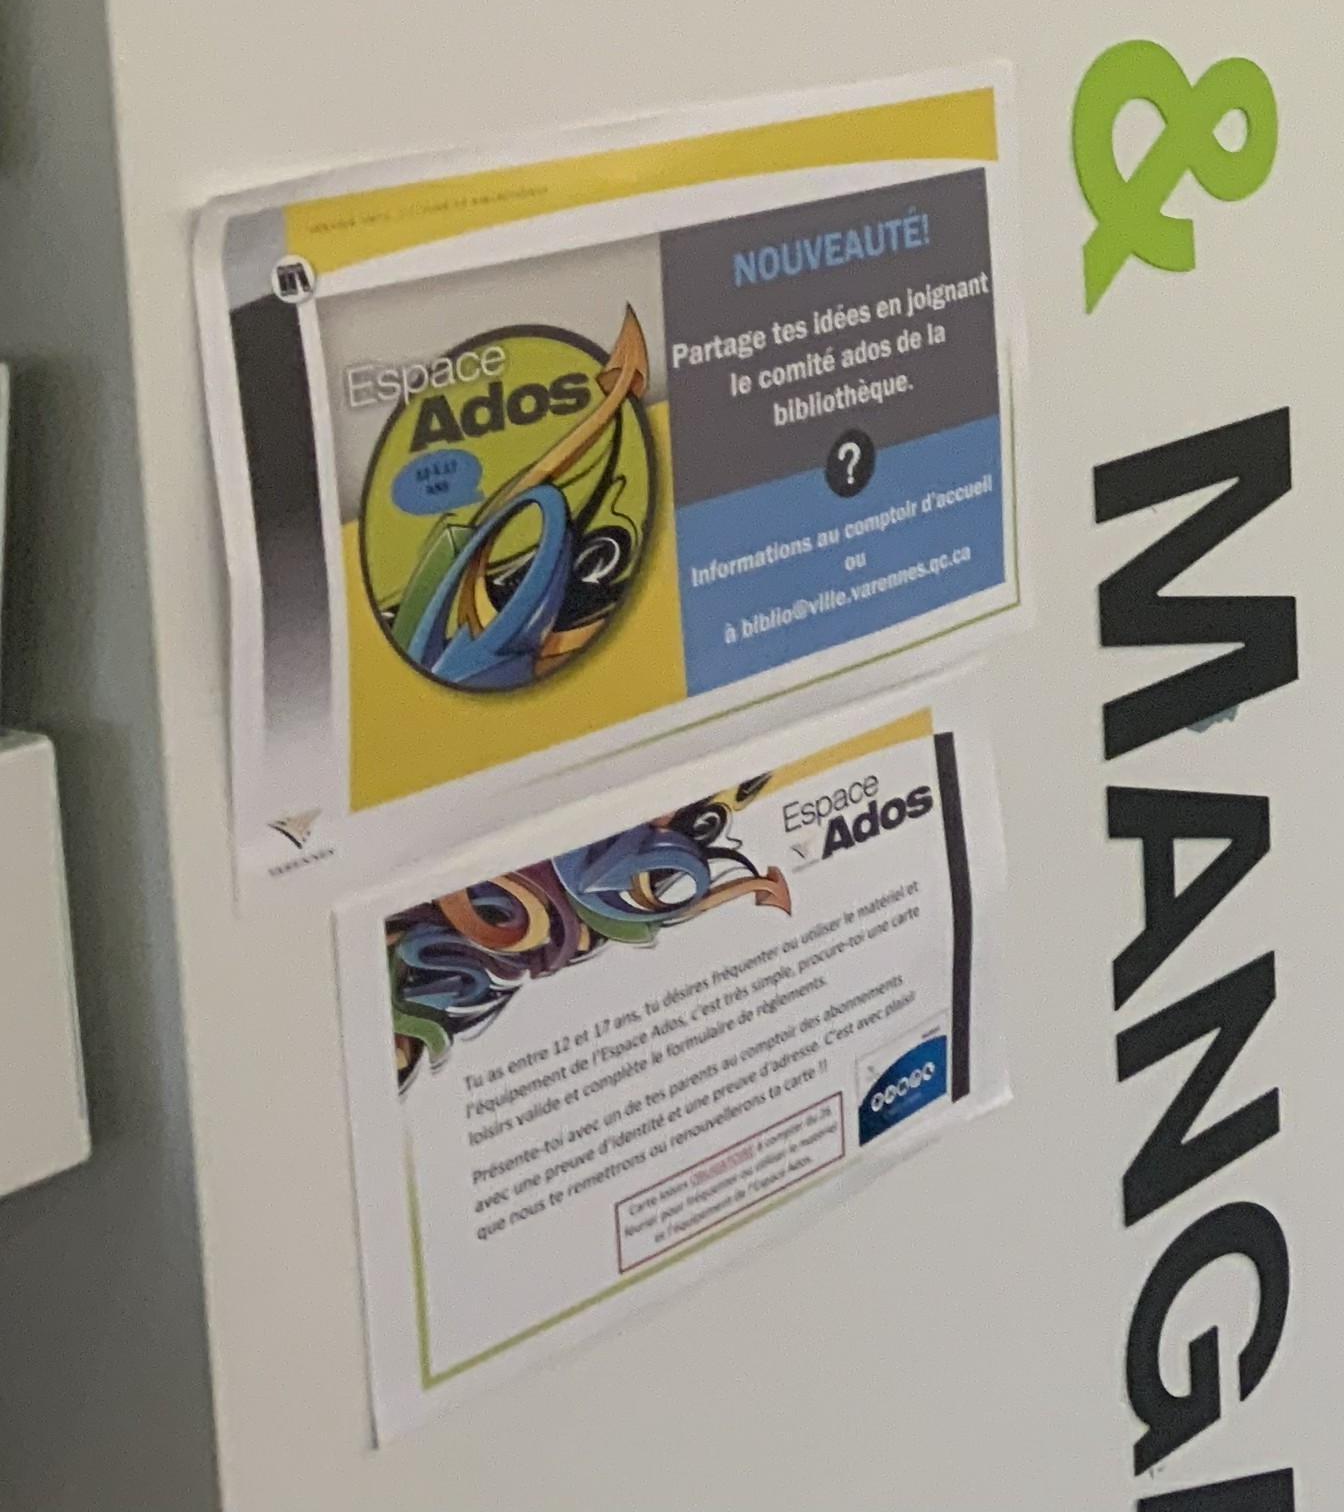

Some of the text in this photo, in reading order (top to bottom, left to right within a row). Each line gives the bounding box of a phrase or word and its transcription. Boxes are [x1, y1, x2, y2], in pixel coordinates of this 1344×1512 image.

[1072, 39, 1278, 314] &
[732, 207, 930, 287] NOUVEAUTÉ!
[672, 271, 990, 369] Partage tes idées en joignant
[730, 323, 946, 396] le comité ados de la
[347, 345, 507, 408] Espace
[409, 372, 592, 454] Ados
[773, 373, 914, 428] bibliothèque.
[691, 474, 993, 588] Informations au comptoir d'accueil
[844, 551, 867, 571] ou
[724, 544, 972, 644] à biblio@ville.varennes.qc.ca
[782, 774, 879, 833] Espace
[822, 785, 933, 860] Ados
[463, 1074, 484, 1091] Tu
[488, 1068, 505, 1084] as
[507, 1048, 549, 1074] entre
[553, 1037, 570, 1056] 12
[575, 1030, 589, 1046] et
[594, 1019, 610, 1038] 17
[645, 1001, 660, 1016] tu
[662, 977, 709, 1008] désires
[712, 946, 779, 983] fréquenter
[782, 938, 799, 954] ou
[801, 918, 841, 944] utiliser
[843, 911, 856, 925] le
[857, 886, 905, 918] matériel
[907, 880, 920, 896] et
[1093, 406, 1299, 1512] MANG
[466, 1066, 568, 1119] l'équipement
[570, 1058, 589, 1076] de
[592, 1032, 647, 1066] l'Espace
[691, 998, 721, 1022] c'est
[723, 987, 748, 1006] très
[798, 930, 865, 975] procure-toi
[867, 920, 889, 940] une
[891, 905, 920, 928] carte
[468, 1118, 514, 1147] loisirs
[515, 1097, 561, 1126] valide
[564, 1089, 580, 1105] et
[582, 1058, 647, 1097] complète
[651, 1050, 663, 1066] le
[666, 1018, 735, 1058] formulaire
[738, 1009, 754, 1026] de
[472, 974, 903, 1185] Présente-toi avec un de tes parents au comptoir des abonnements
[474, 1189, 510, 1214] avec
[513, 1174, 542, 1195] une
[544, 1148, 595, 1183] preuve
[599, 1113, 665, 1155] d'identité
[667, 1106, 682, 1123] et
[684, 1094, 709, 1115] une
[712, 1071, 757, 1102] preuve
[824, 1023, 854, 1045] C'est
[856, 1009, 882, 1031] avec
[476, 1218, 506, 1240] que
[509, 1199, 546, 1225] nous
[549, 1190, 564, 1206] te
[568, 1152, 646, 1196] remettrons
[649, 1142, 667, 1158] ou
[670, 1094, 766, 1146] renouvellerons
[769, 1084, 781, 1099] ta
[783, 1066, 815, 1090] carte
